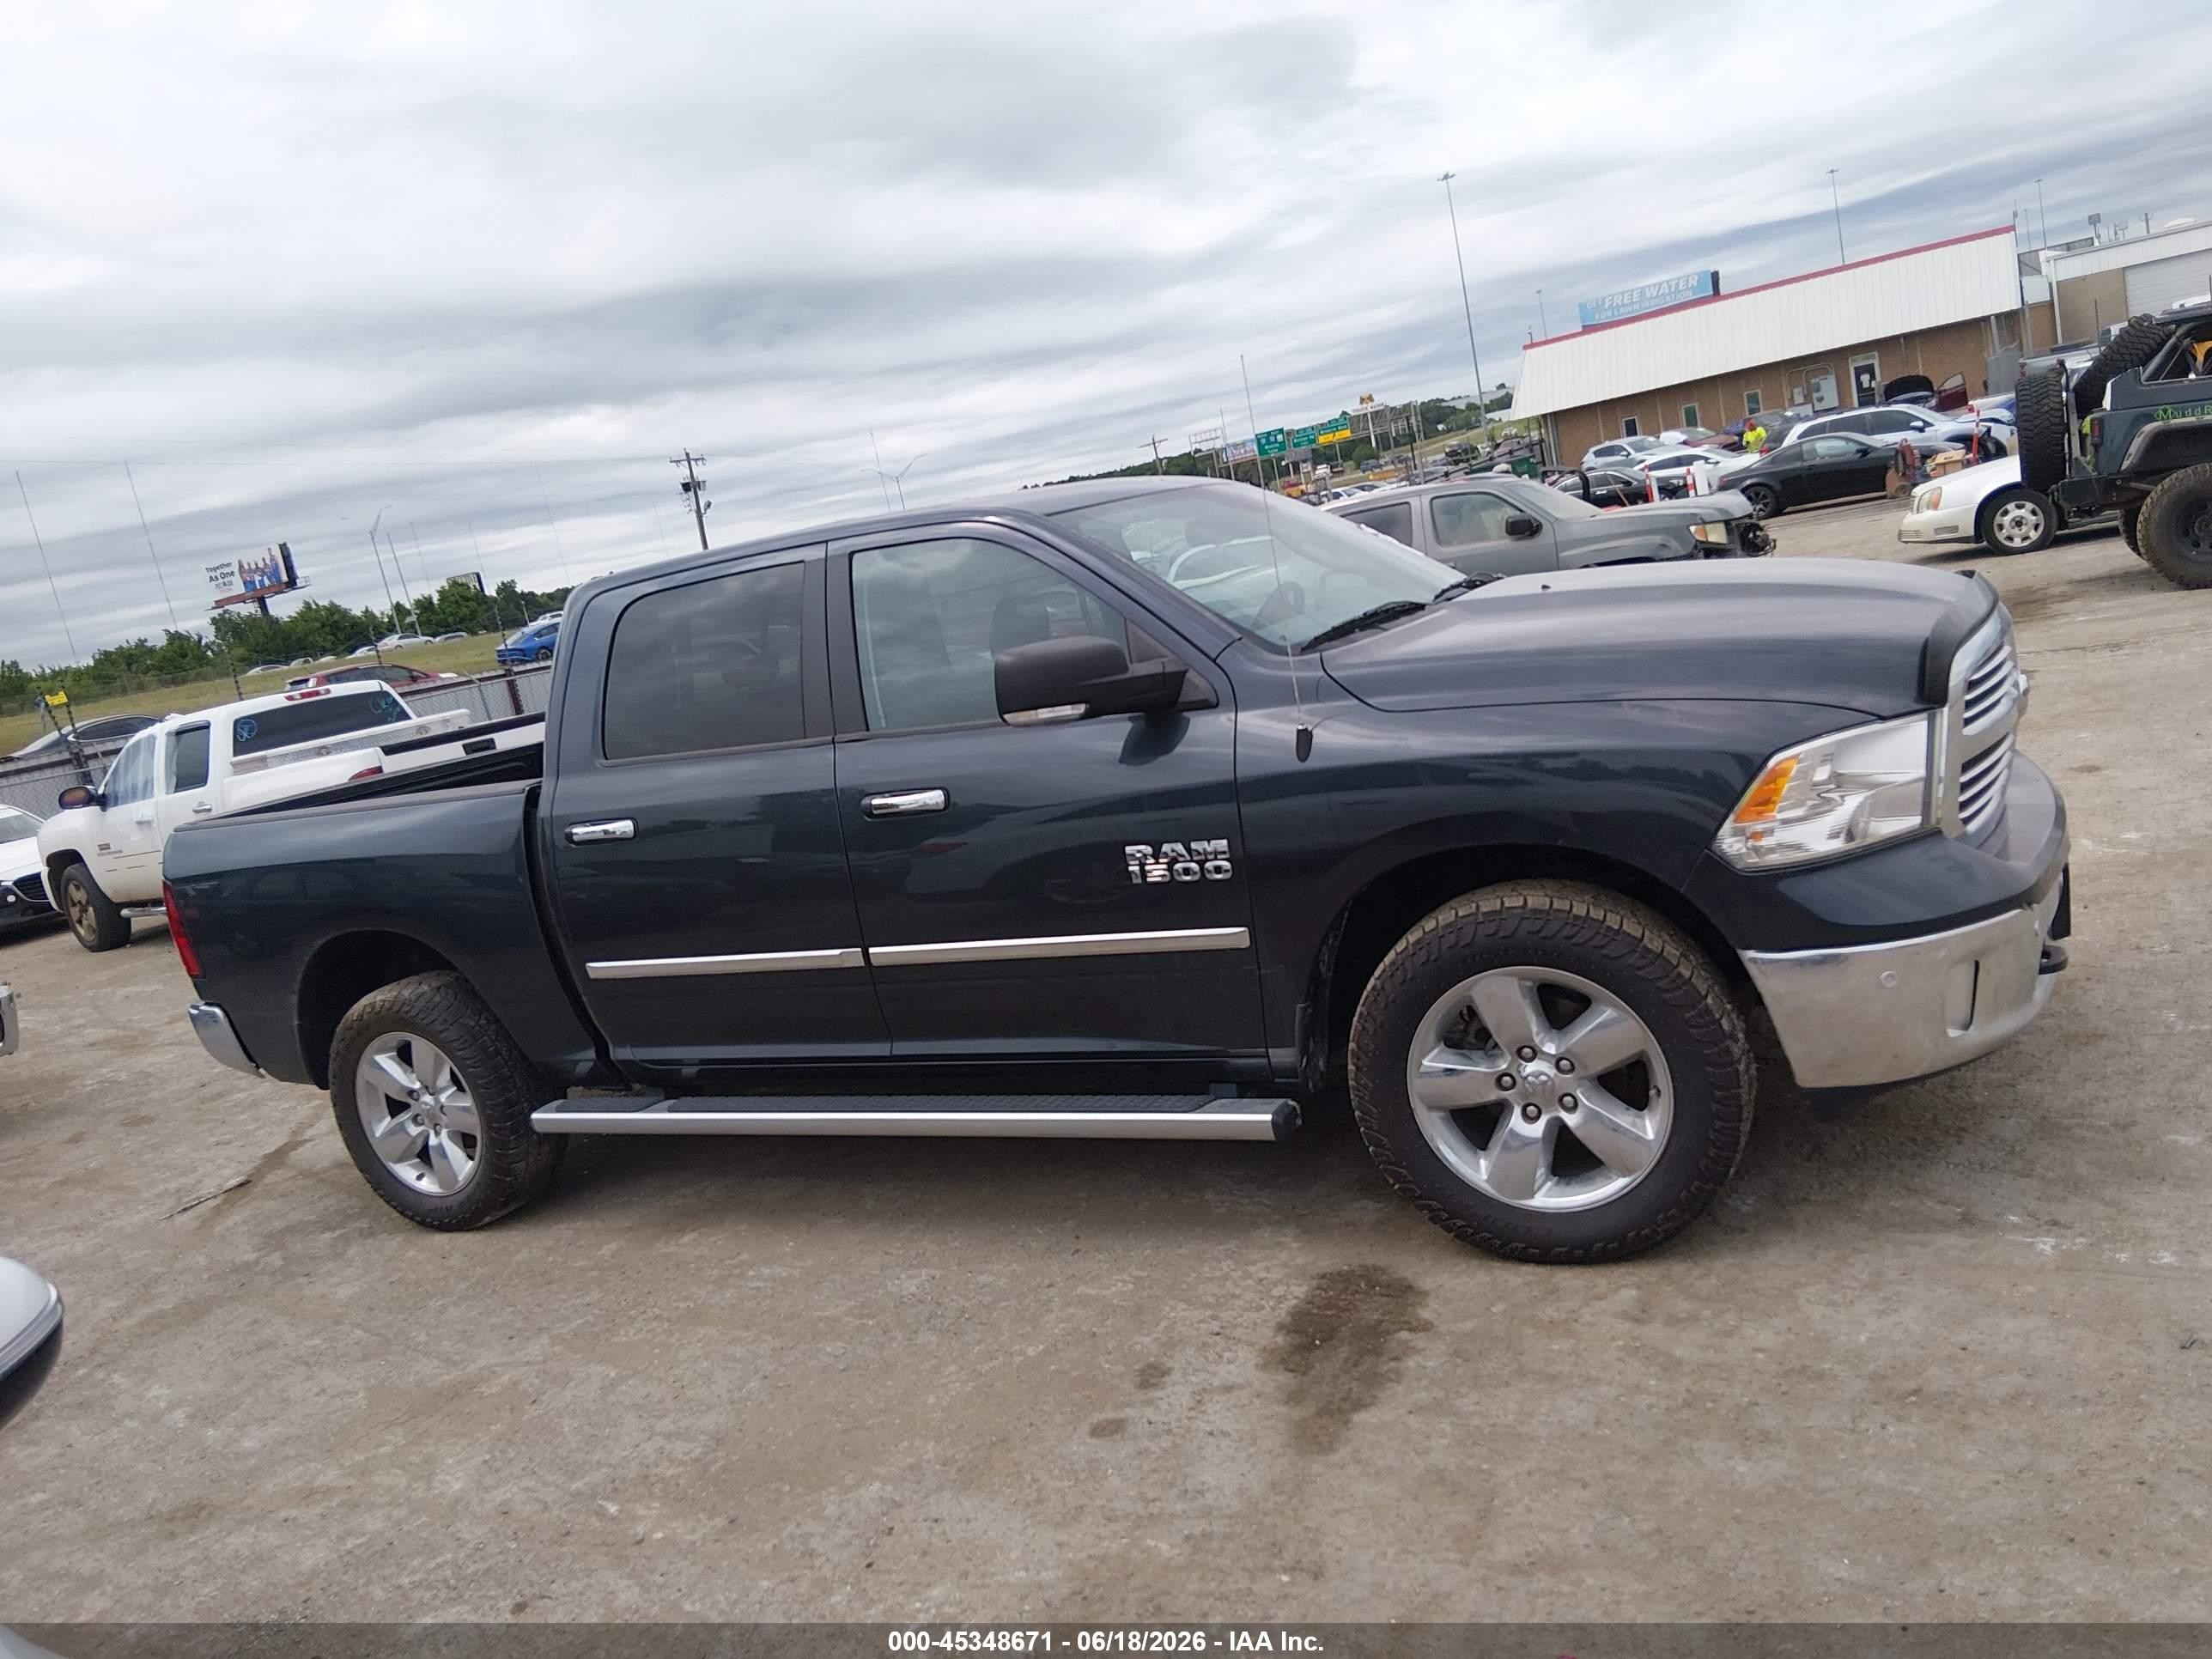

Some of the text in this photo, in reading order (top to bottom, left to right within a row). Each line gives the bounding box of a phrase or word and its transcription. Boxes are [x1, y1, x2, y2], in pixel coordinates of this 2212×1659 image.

[1587, 276, 1698, 308] GET FREE WATER
[205, 562, 232, 574] Together
[209, 570, 235, 584] As One
[1124, 838, 1231, 866] RAM
[1127, 860, 1233, 884] 1500
